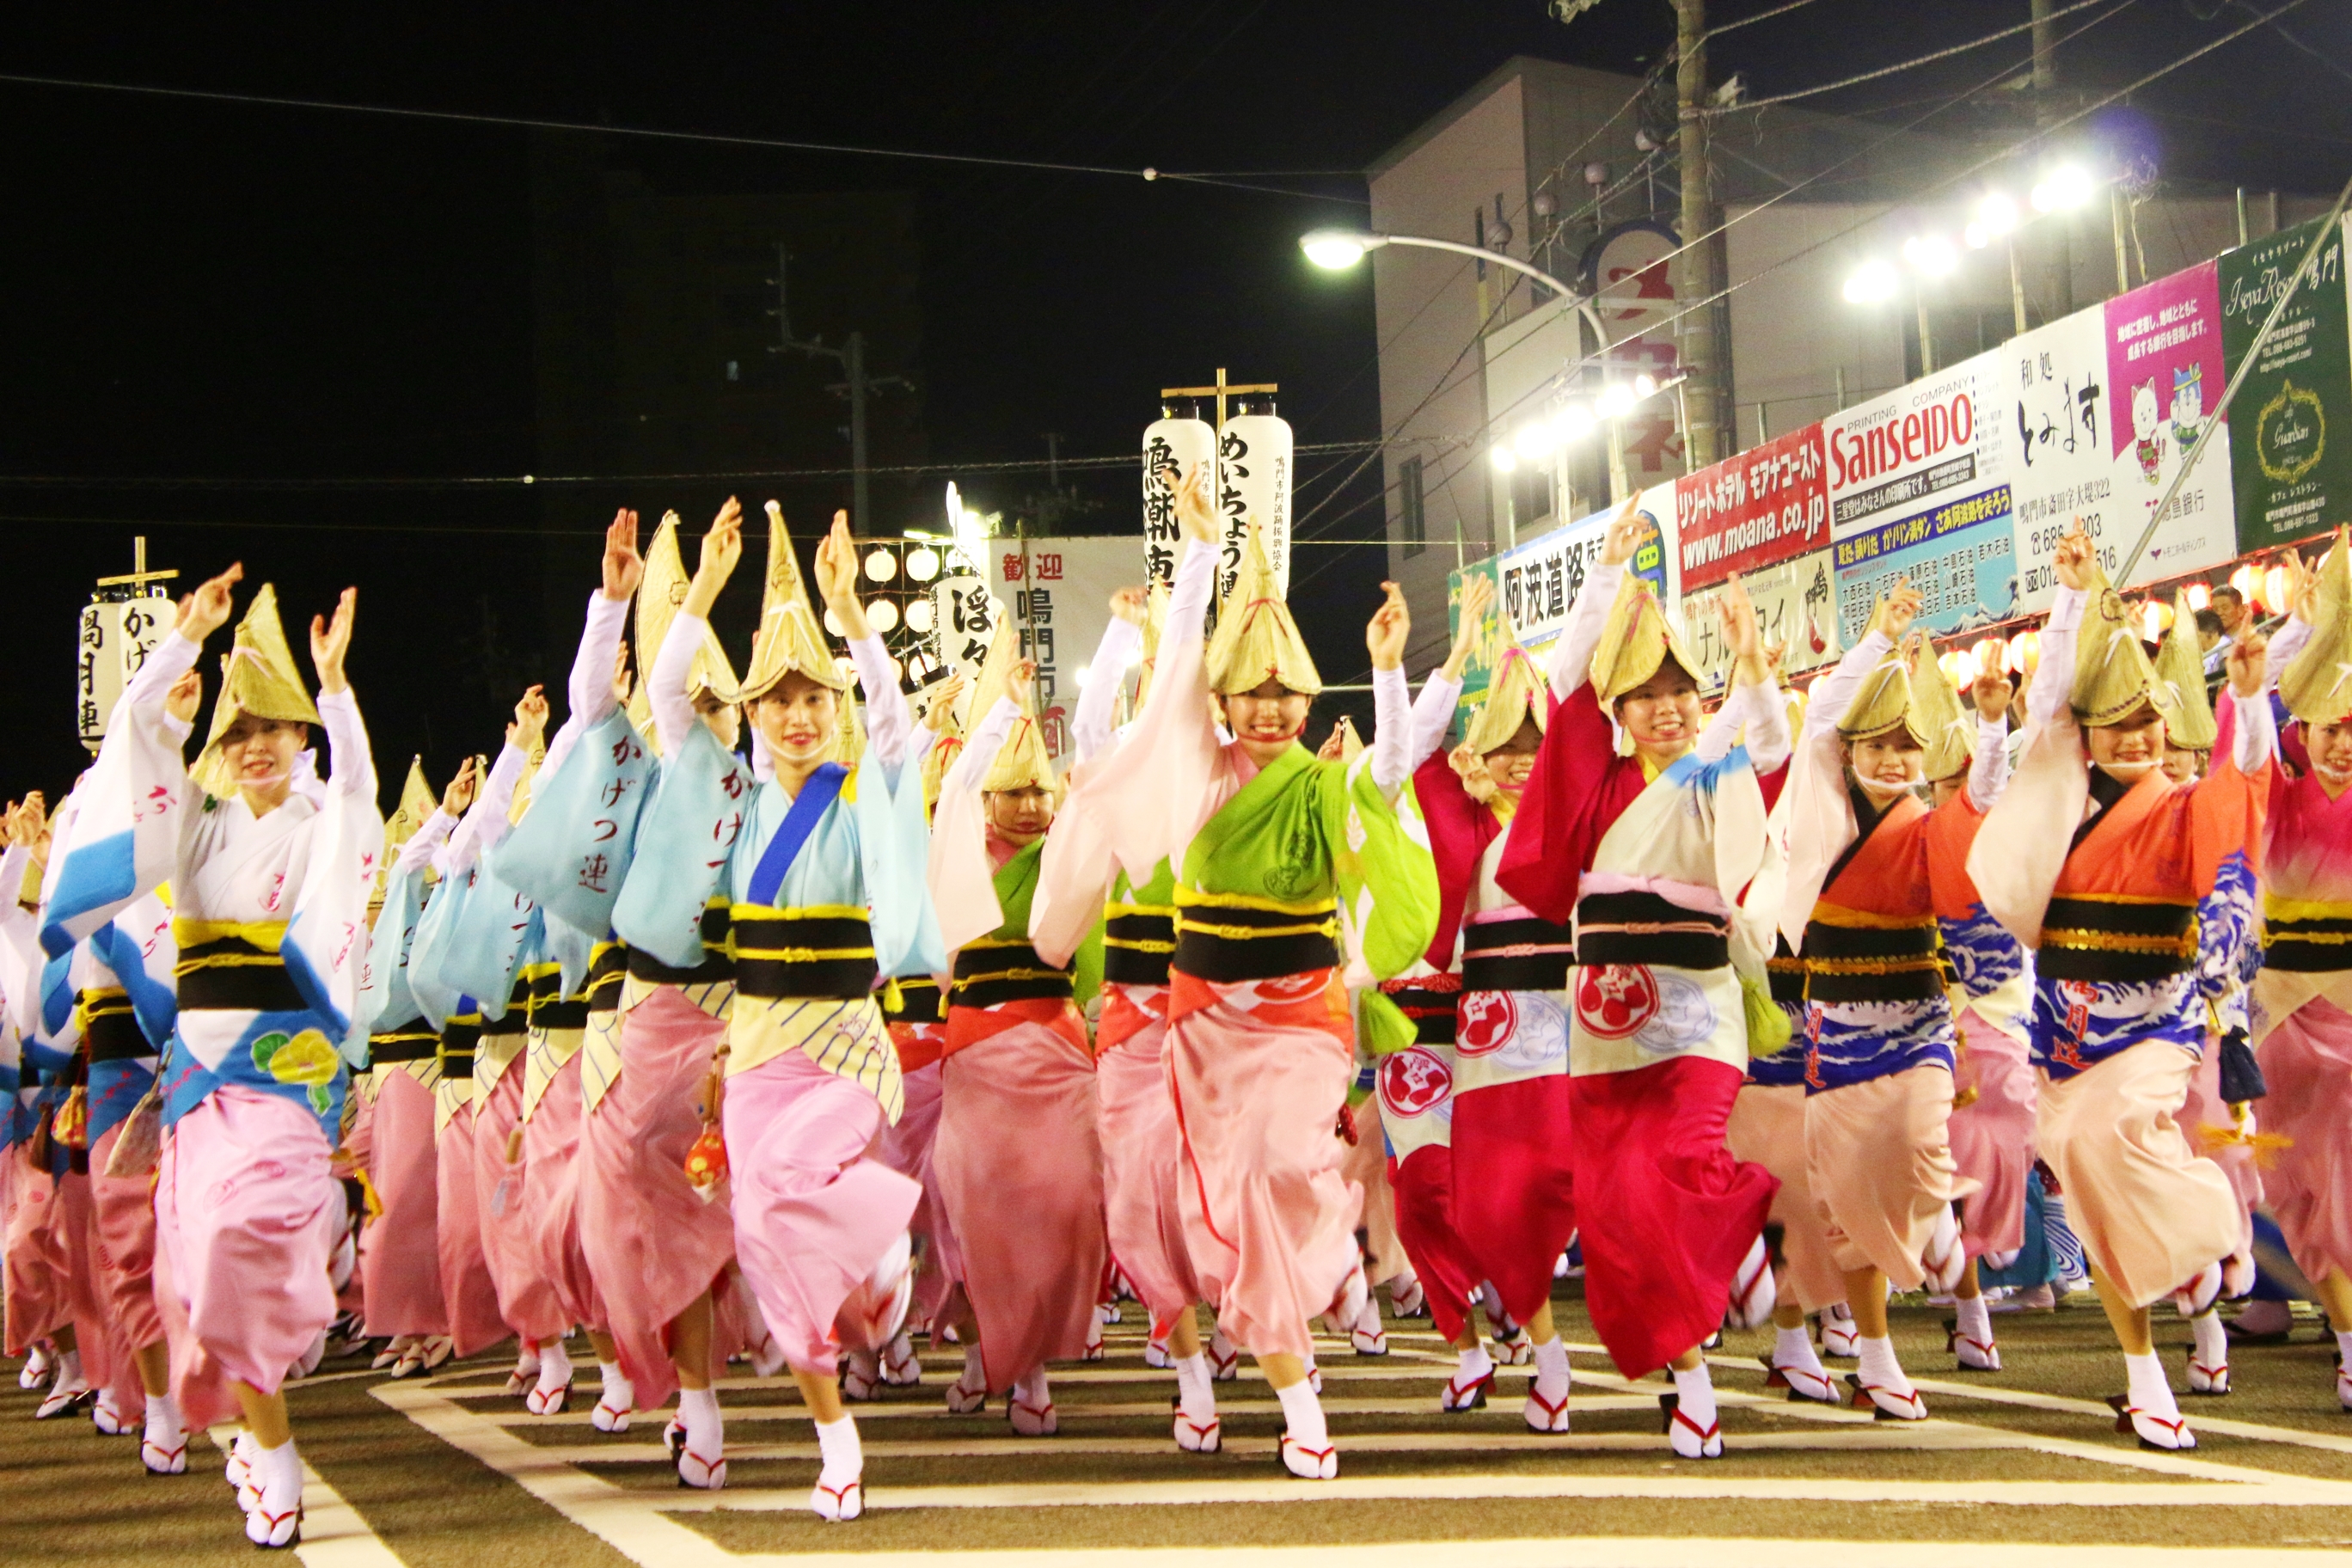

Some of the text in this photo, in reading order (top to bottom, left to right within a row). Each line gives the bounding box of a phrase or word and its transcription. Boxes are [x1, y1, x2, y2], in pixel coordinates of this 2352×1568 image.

[2021, 352, 2053, 390] 和処
[1847, 376, 1969, 433] PRINTING COMPANY
[1750, 439, 1822, 500] モアナコースト
[1682, 486, 1825, 572] www.moana.co.jp
[1002, 553, 1063, 582] 歓迎
[579, 735, 642, 894] かげつ連
